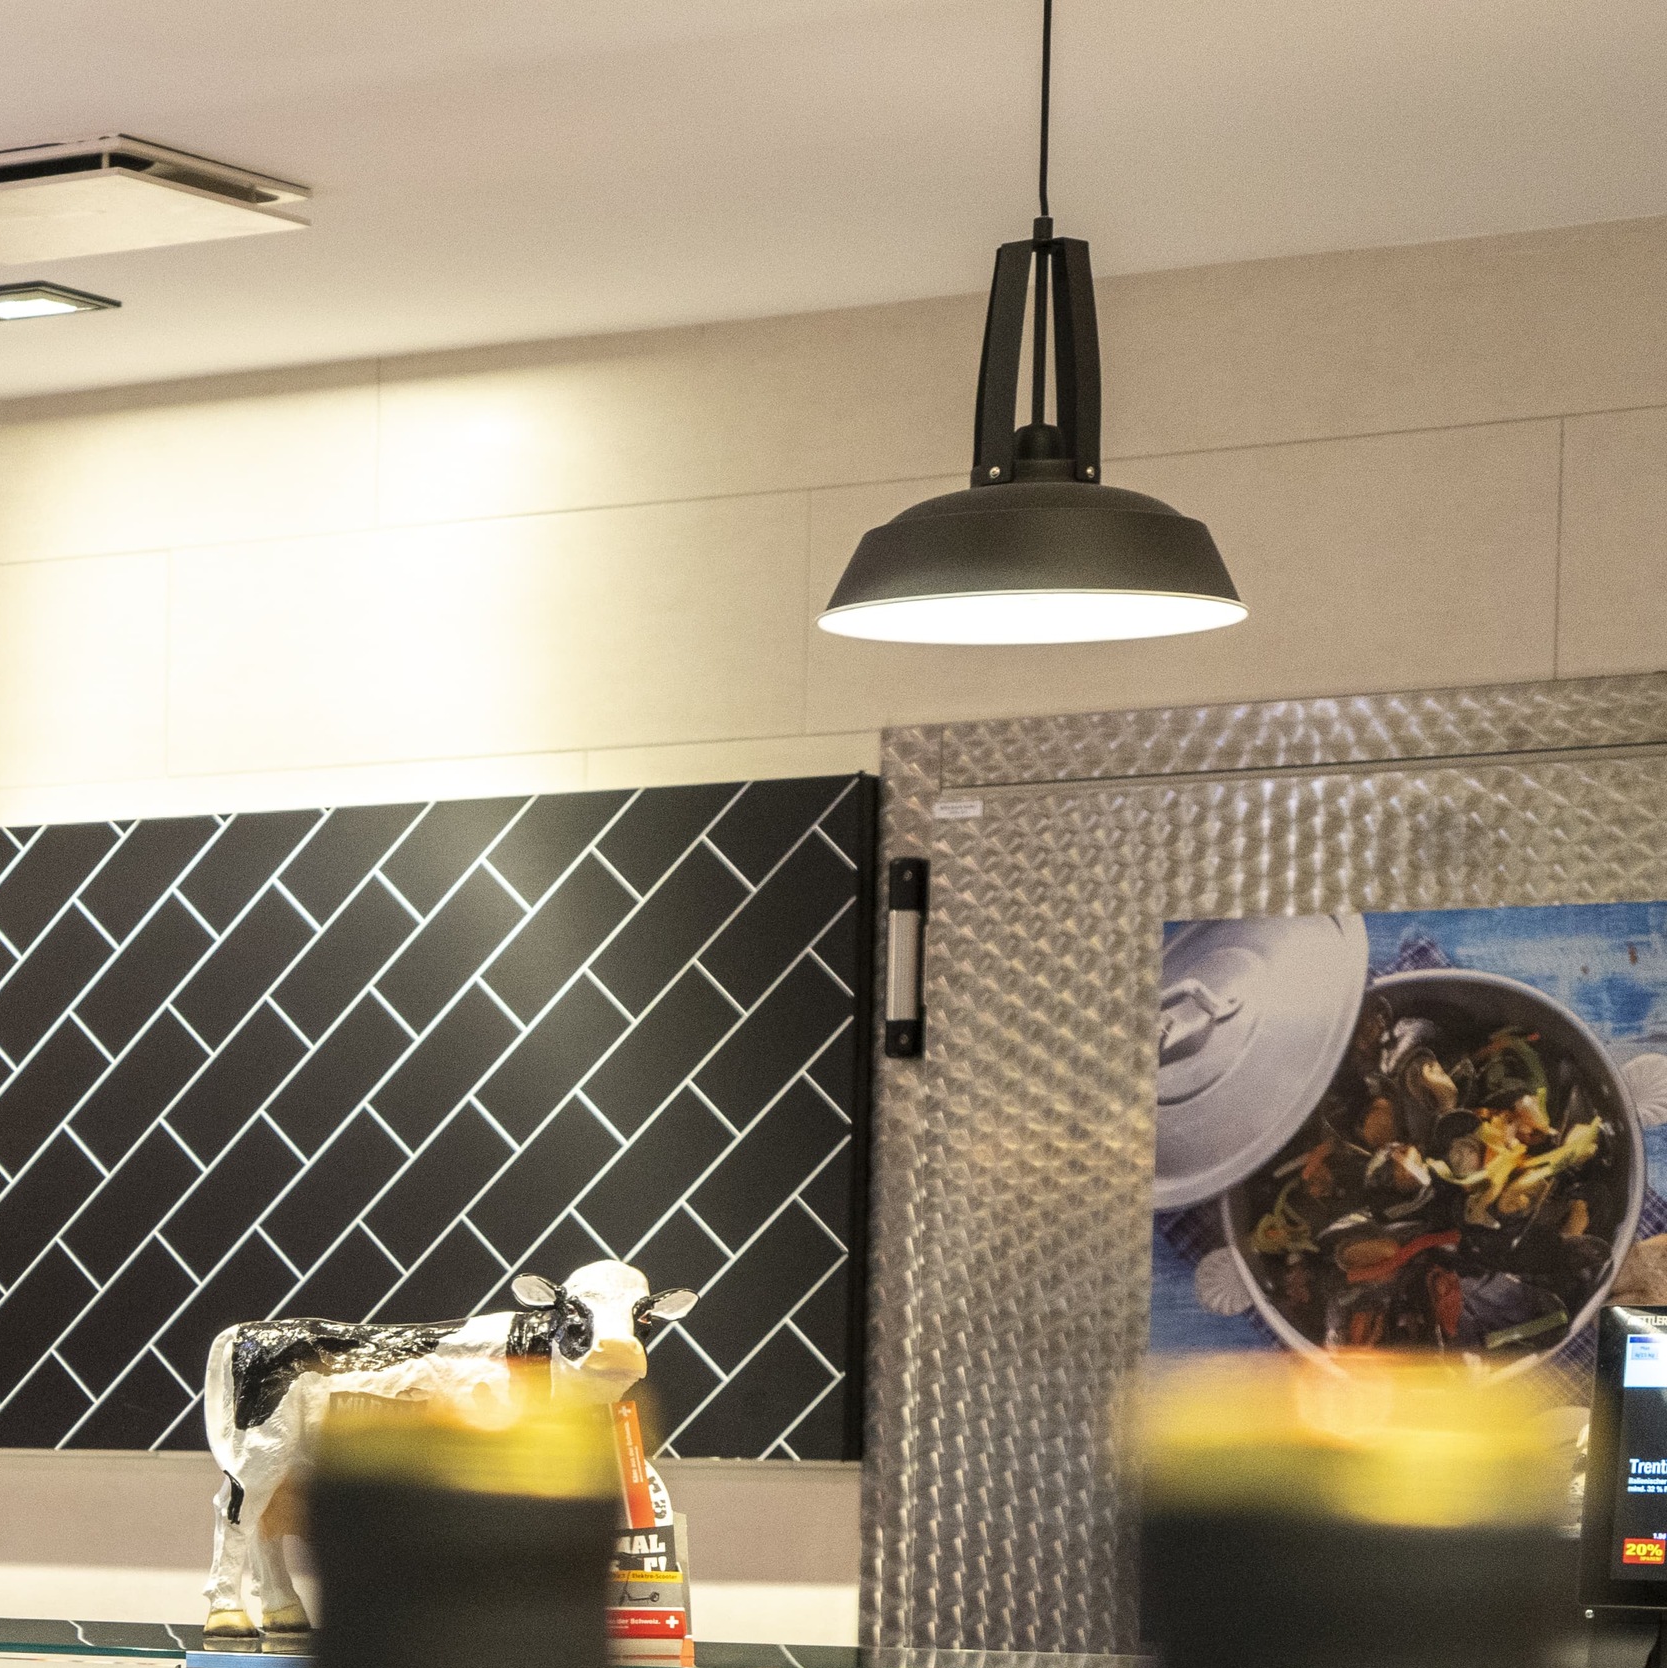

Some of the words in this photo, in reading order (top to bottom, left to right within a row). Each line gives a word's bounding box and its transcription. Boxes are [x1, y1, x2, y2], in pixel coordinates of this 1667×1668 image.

[1629, 1458, 1667, 1474] Trent
[1625, 1543, 1663, 1557] 20%
[631, 1571, 677, 1579] Elektro-Scooter
